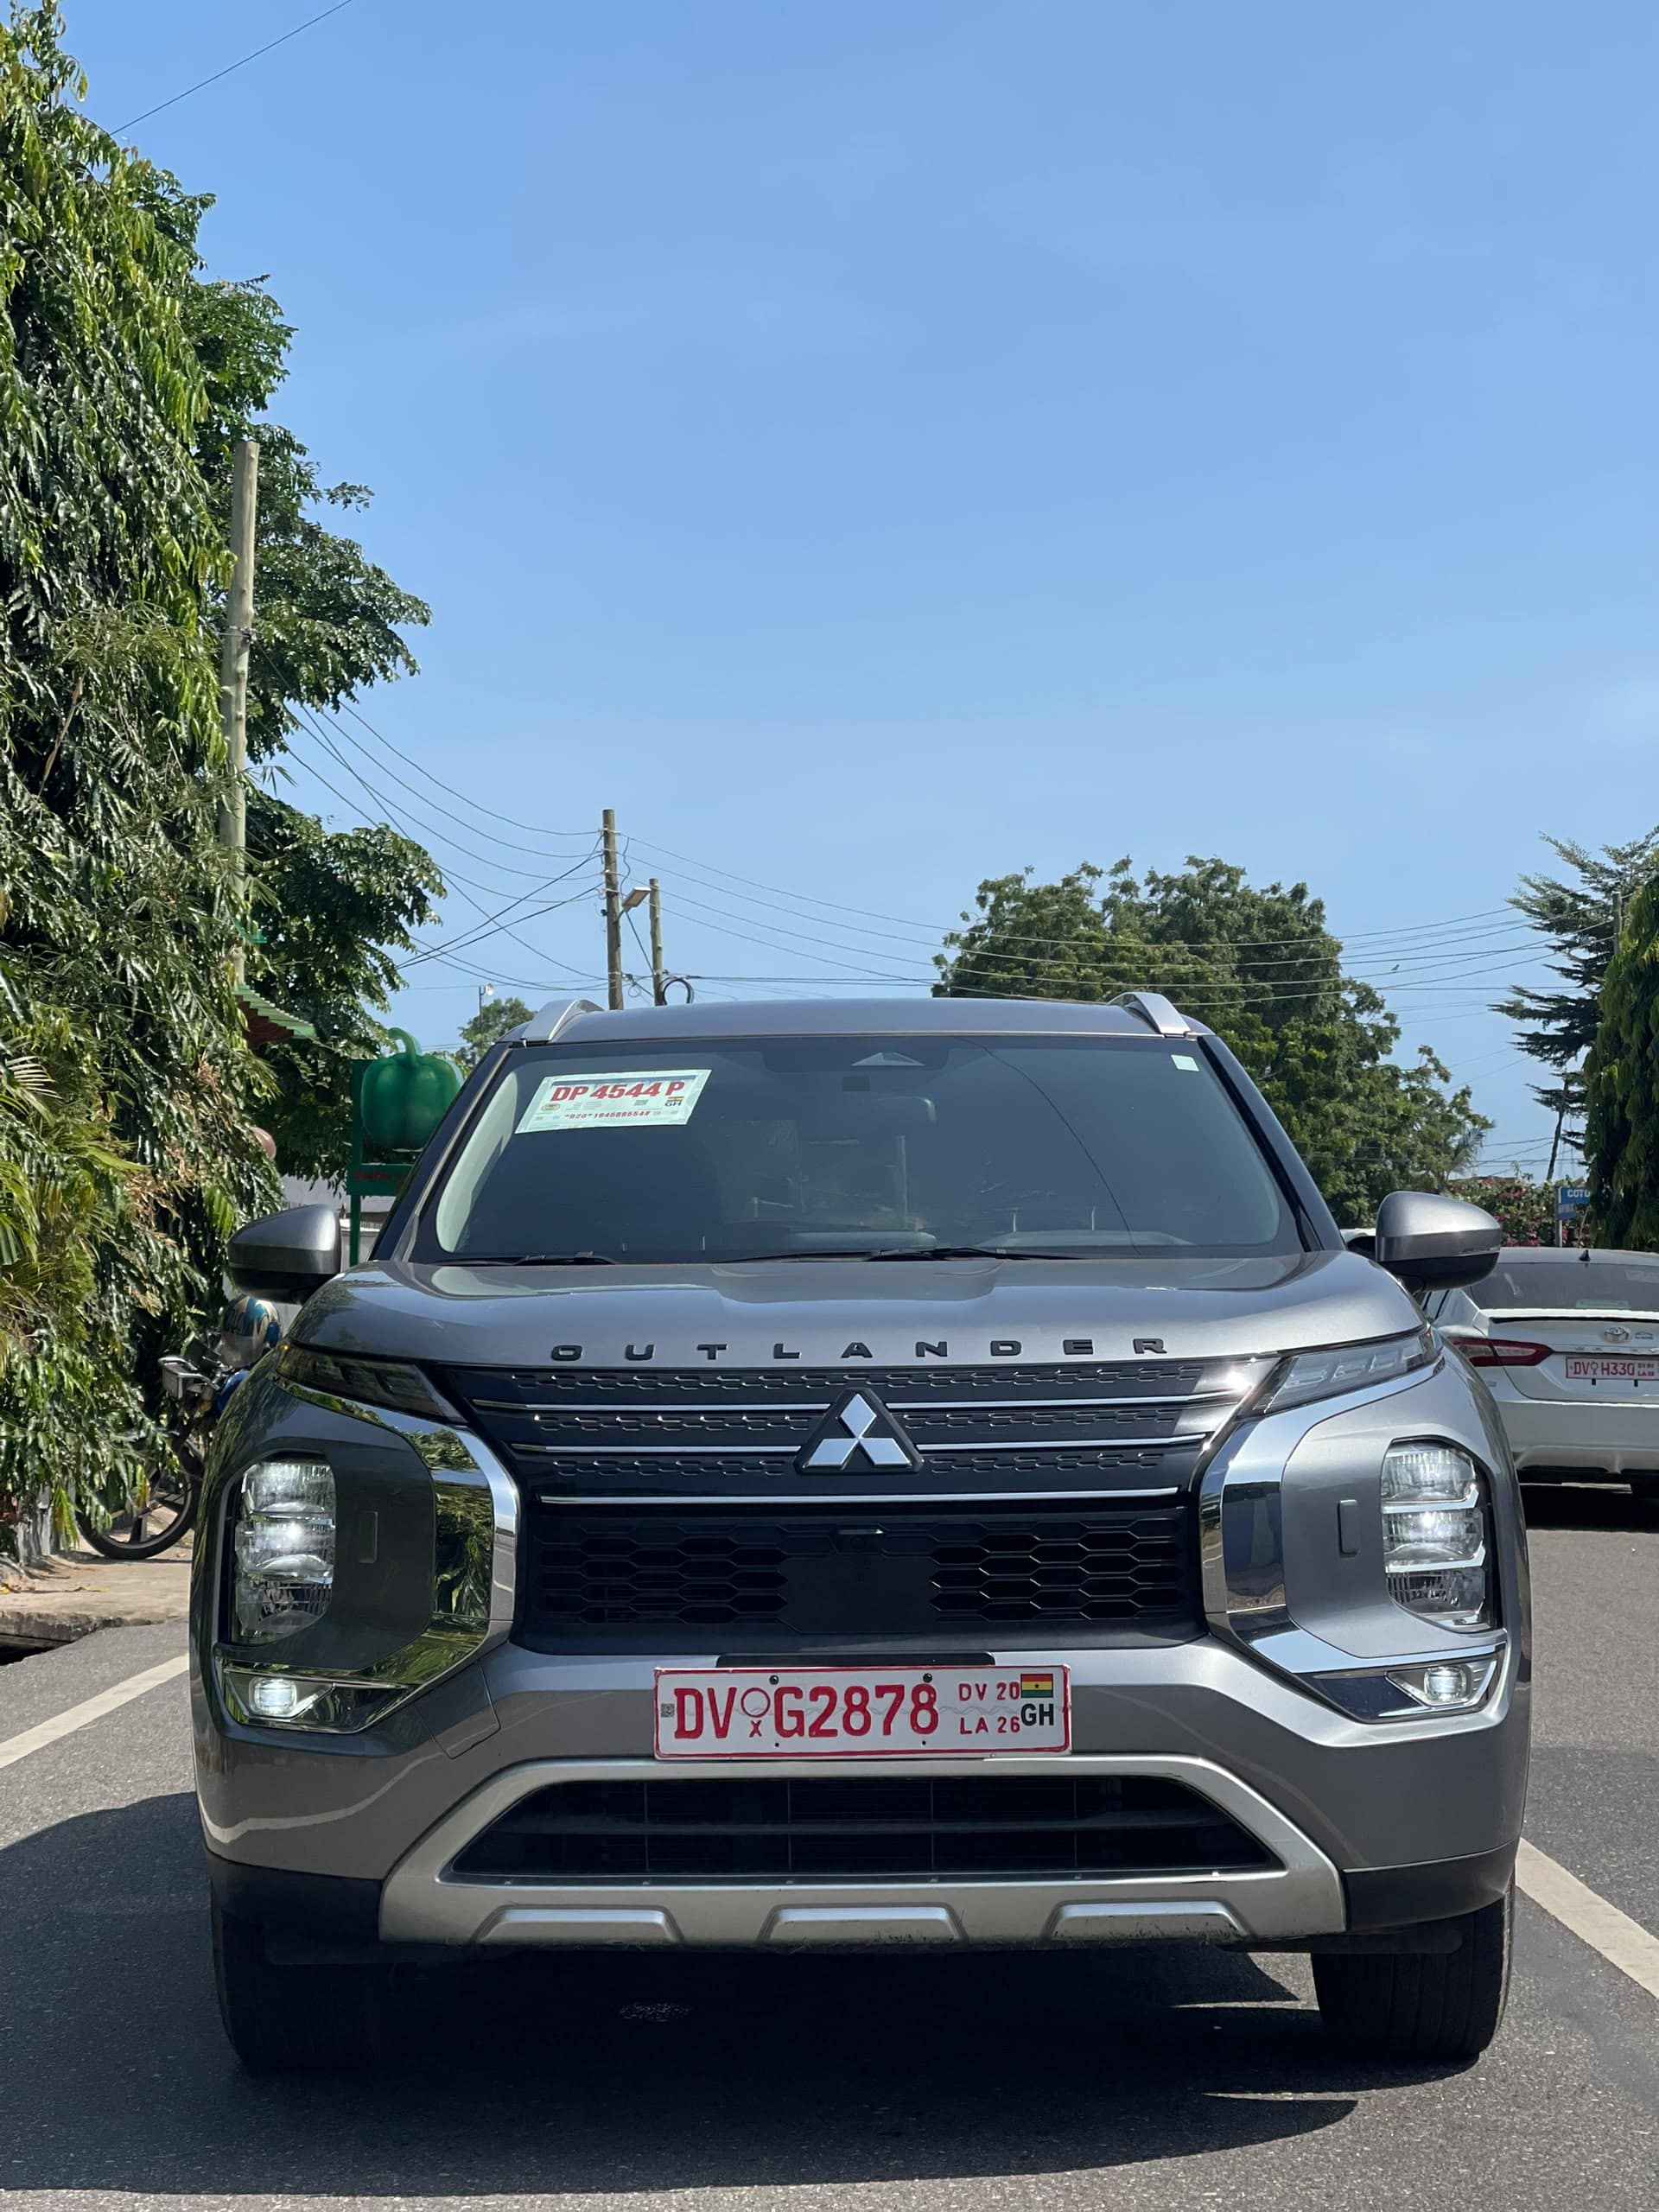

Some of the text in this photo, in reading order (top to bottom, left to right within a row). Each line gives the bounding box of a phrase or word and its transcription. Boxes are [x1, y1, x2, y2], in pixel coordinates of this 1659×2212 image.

[550, 1081, 685, 1102] DP 4544 P
[550, 1338, 1167, 1362] OUTLANDER
[1573, 1361, 1590, 1375] DV
[958, 1681, 1020, 1701] DV 20
[674, 1683, 939, 1739] DV G2878
[1020, 1703, 1054, 1726] GH
[960, 1715, 1020, 1735] LA 26
